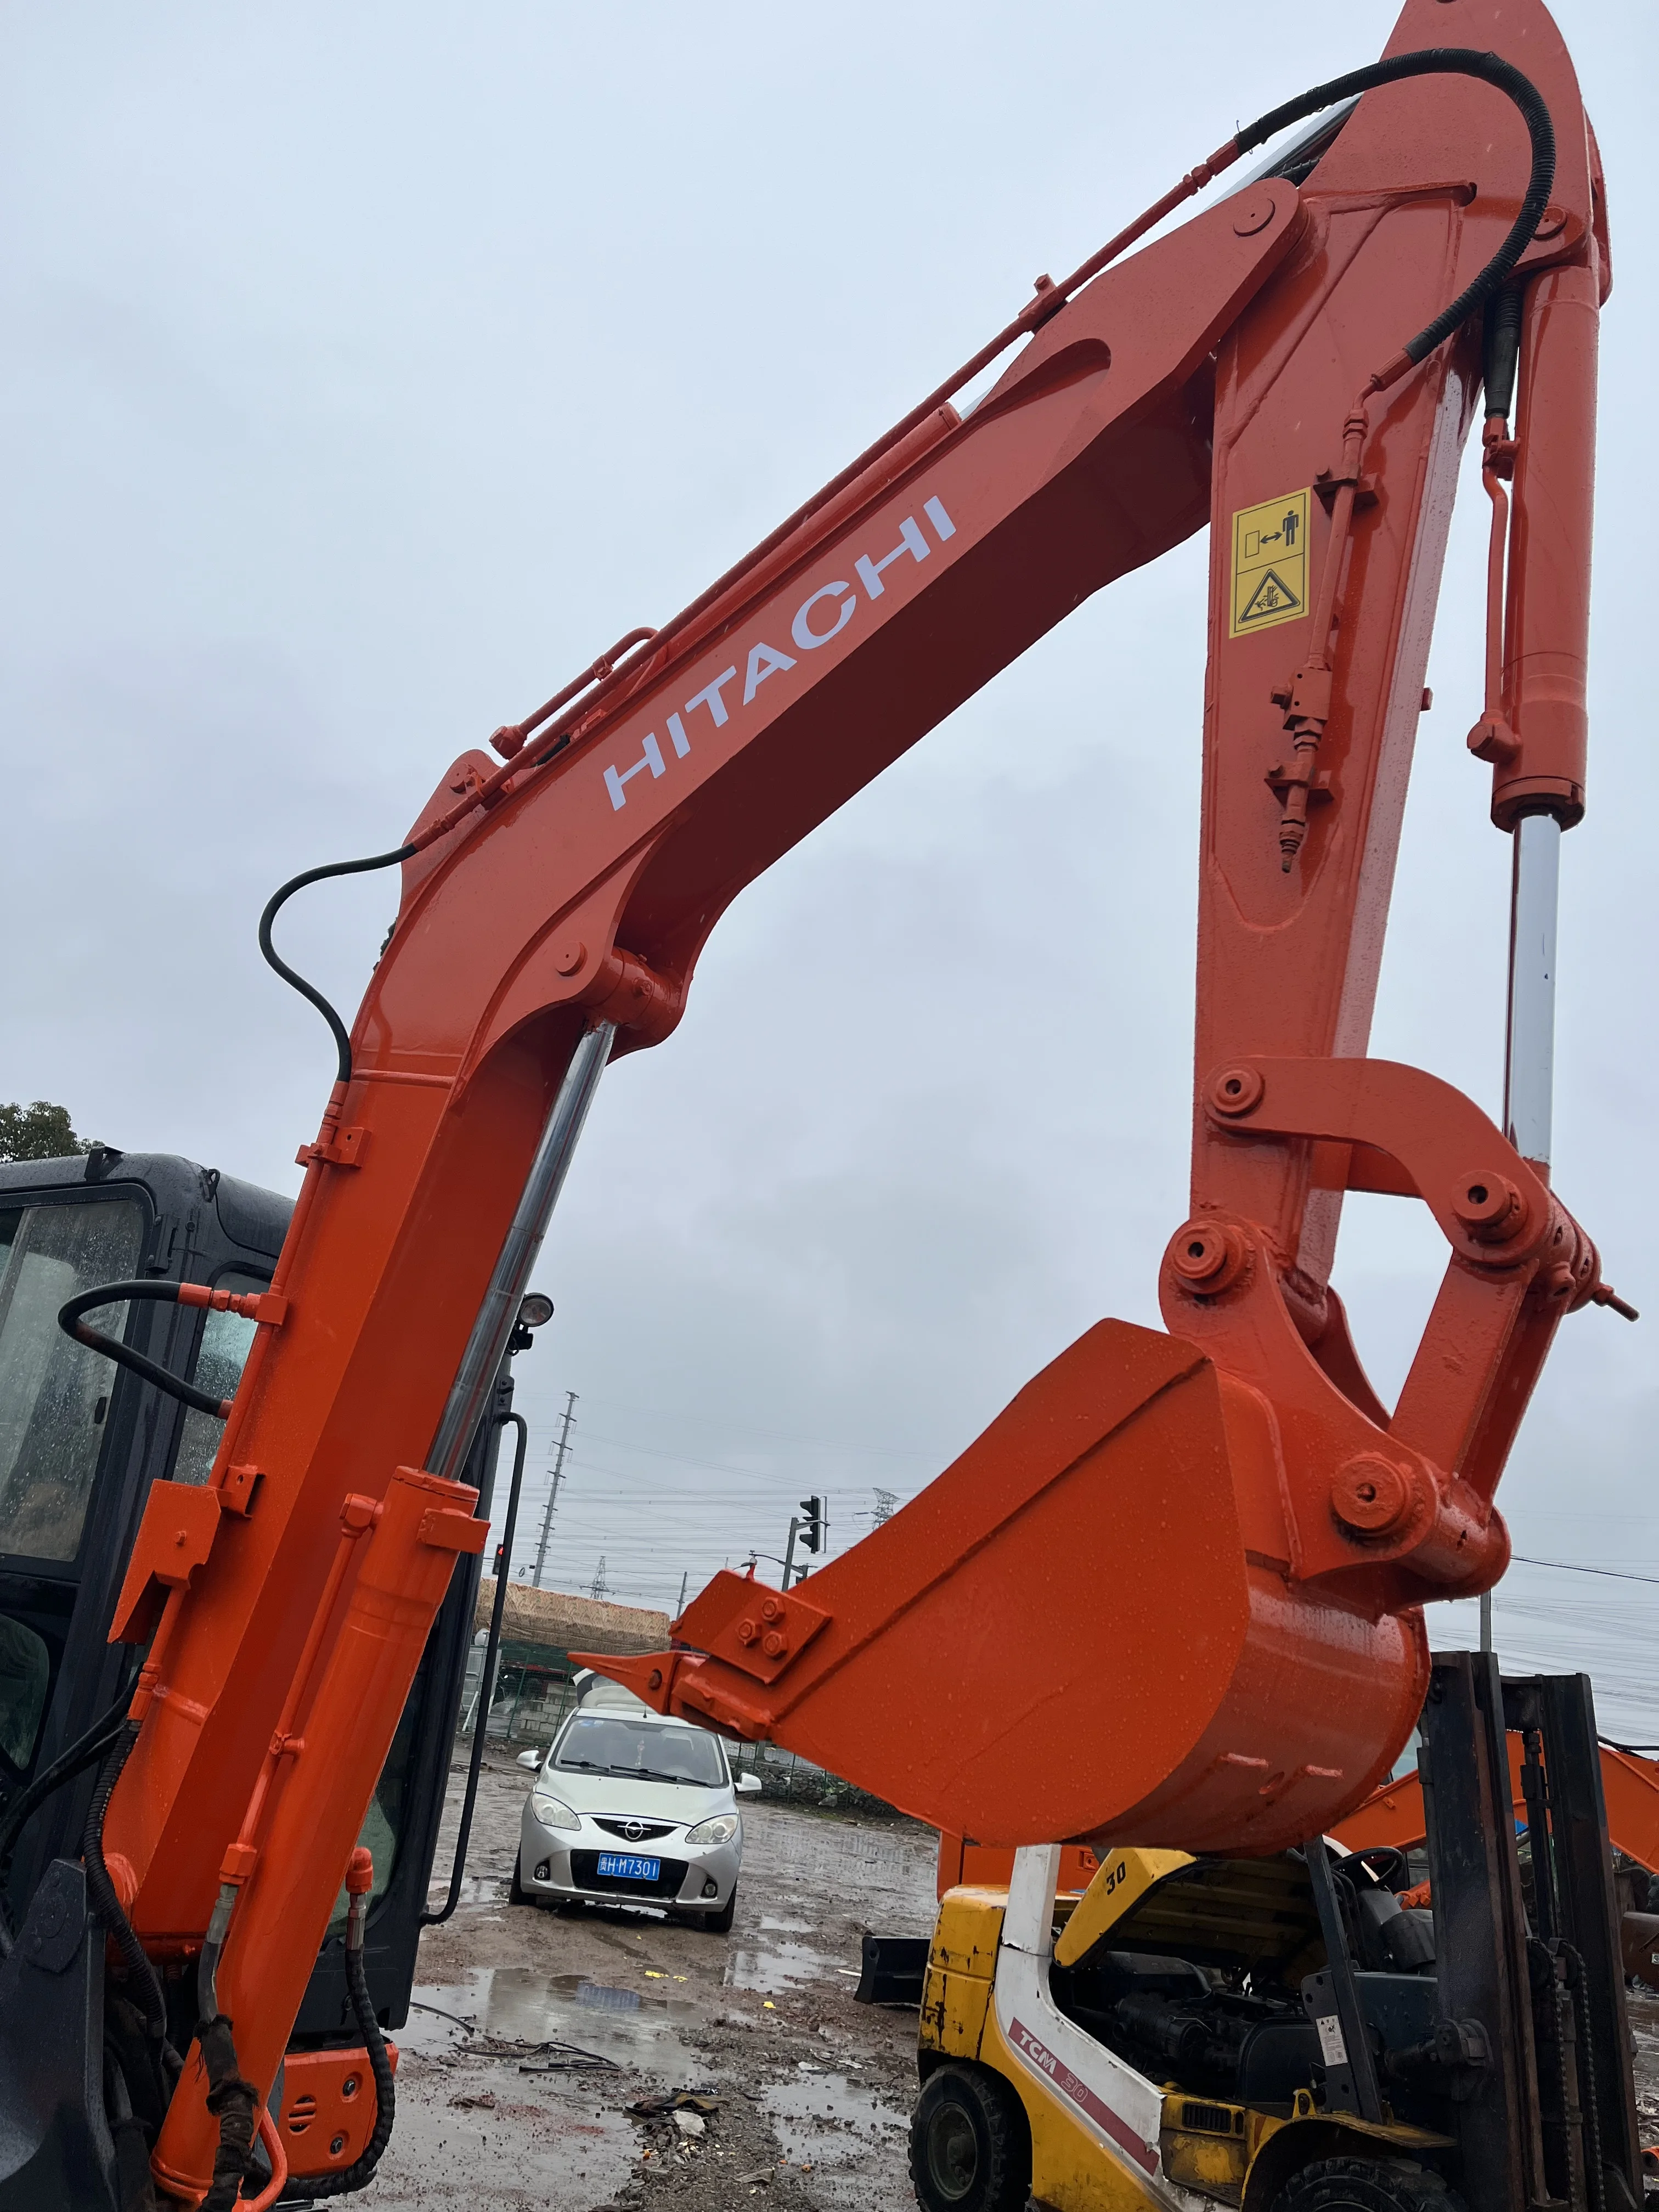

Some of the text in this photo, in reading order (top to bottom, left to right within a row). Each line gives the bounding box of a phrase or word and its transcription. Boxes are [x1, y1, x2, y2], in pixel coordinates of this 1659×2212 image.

[603, 495, 956, 811] HITACHI
[1106, 1861, 1126, 1896] 30
[1020, 2030, 1088, 2102] TCM 30
